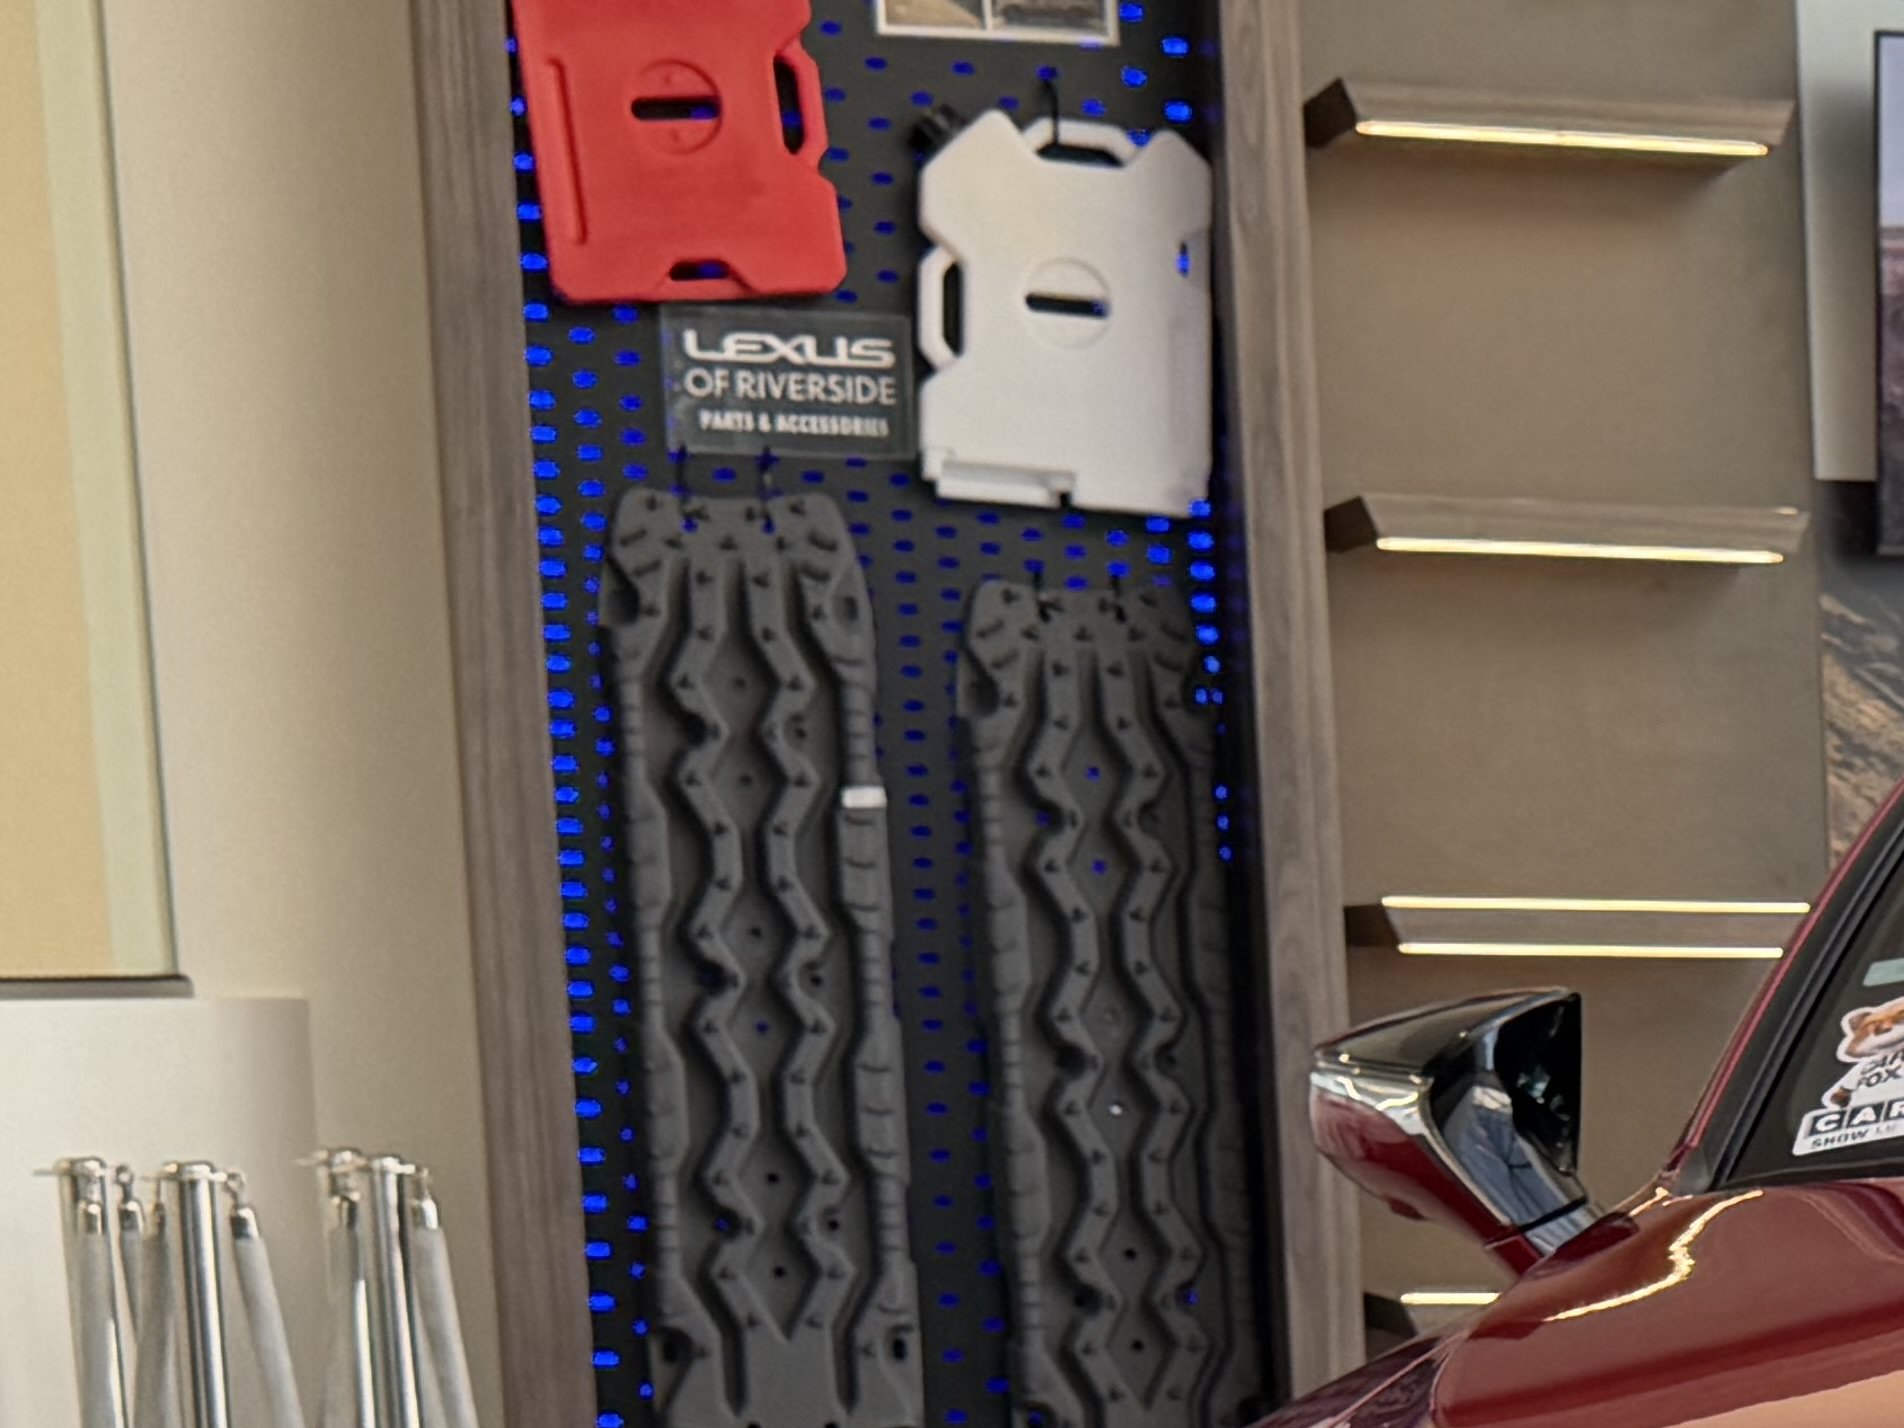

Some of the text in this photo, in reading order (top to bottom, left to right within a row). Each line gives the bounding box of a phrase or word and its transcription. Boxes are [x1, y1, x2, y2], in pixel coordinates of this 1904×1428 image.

[682, 329, 896, 369] LEXUS
[684, 367, 897, 405] OF RIVERSIDE
[699, 409, 754, 431] PARTS
[775, 413, 890, 437] ACCESSORIES
[1811, 1128, 1869, 1149] SHOW
